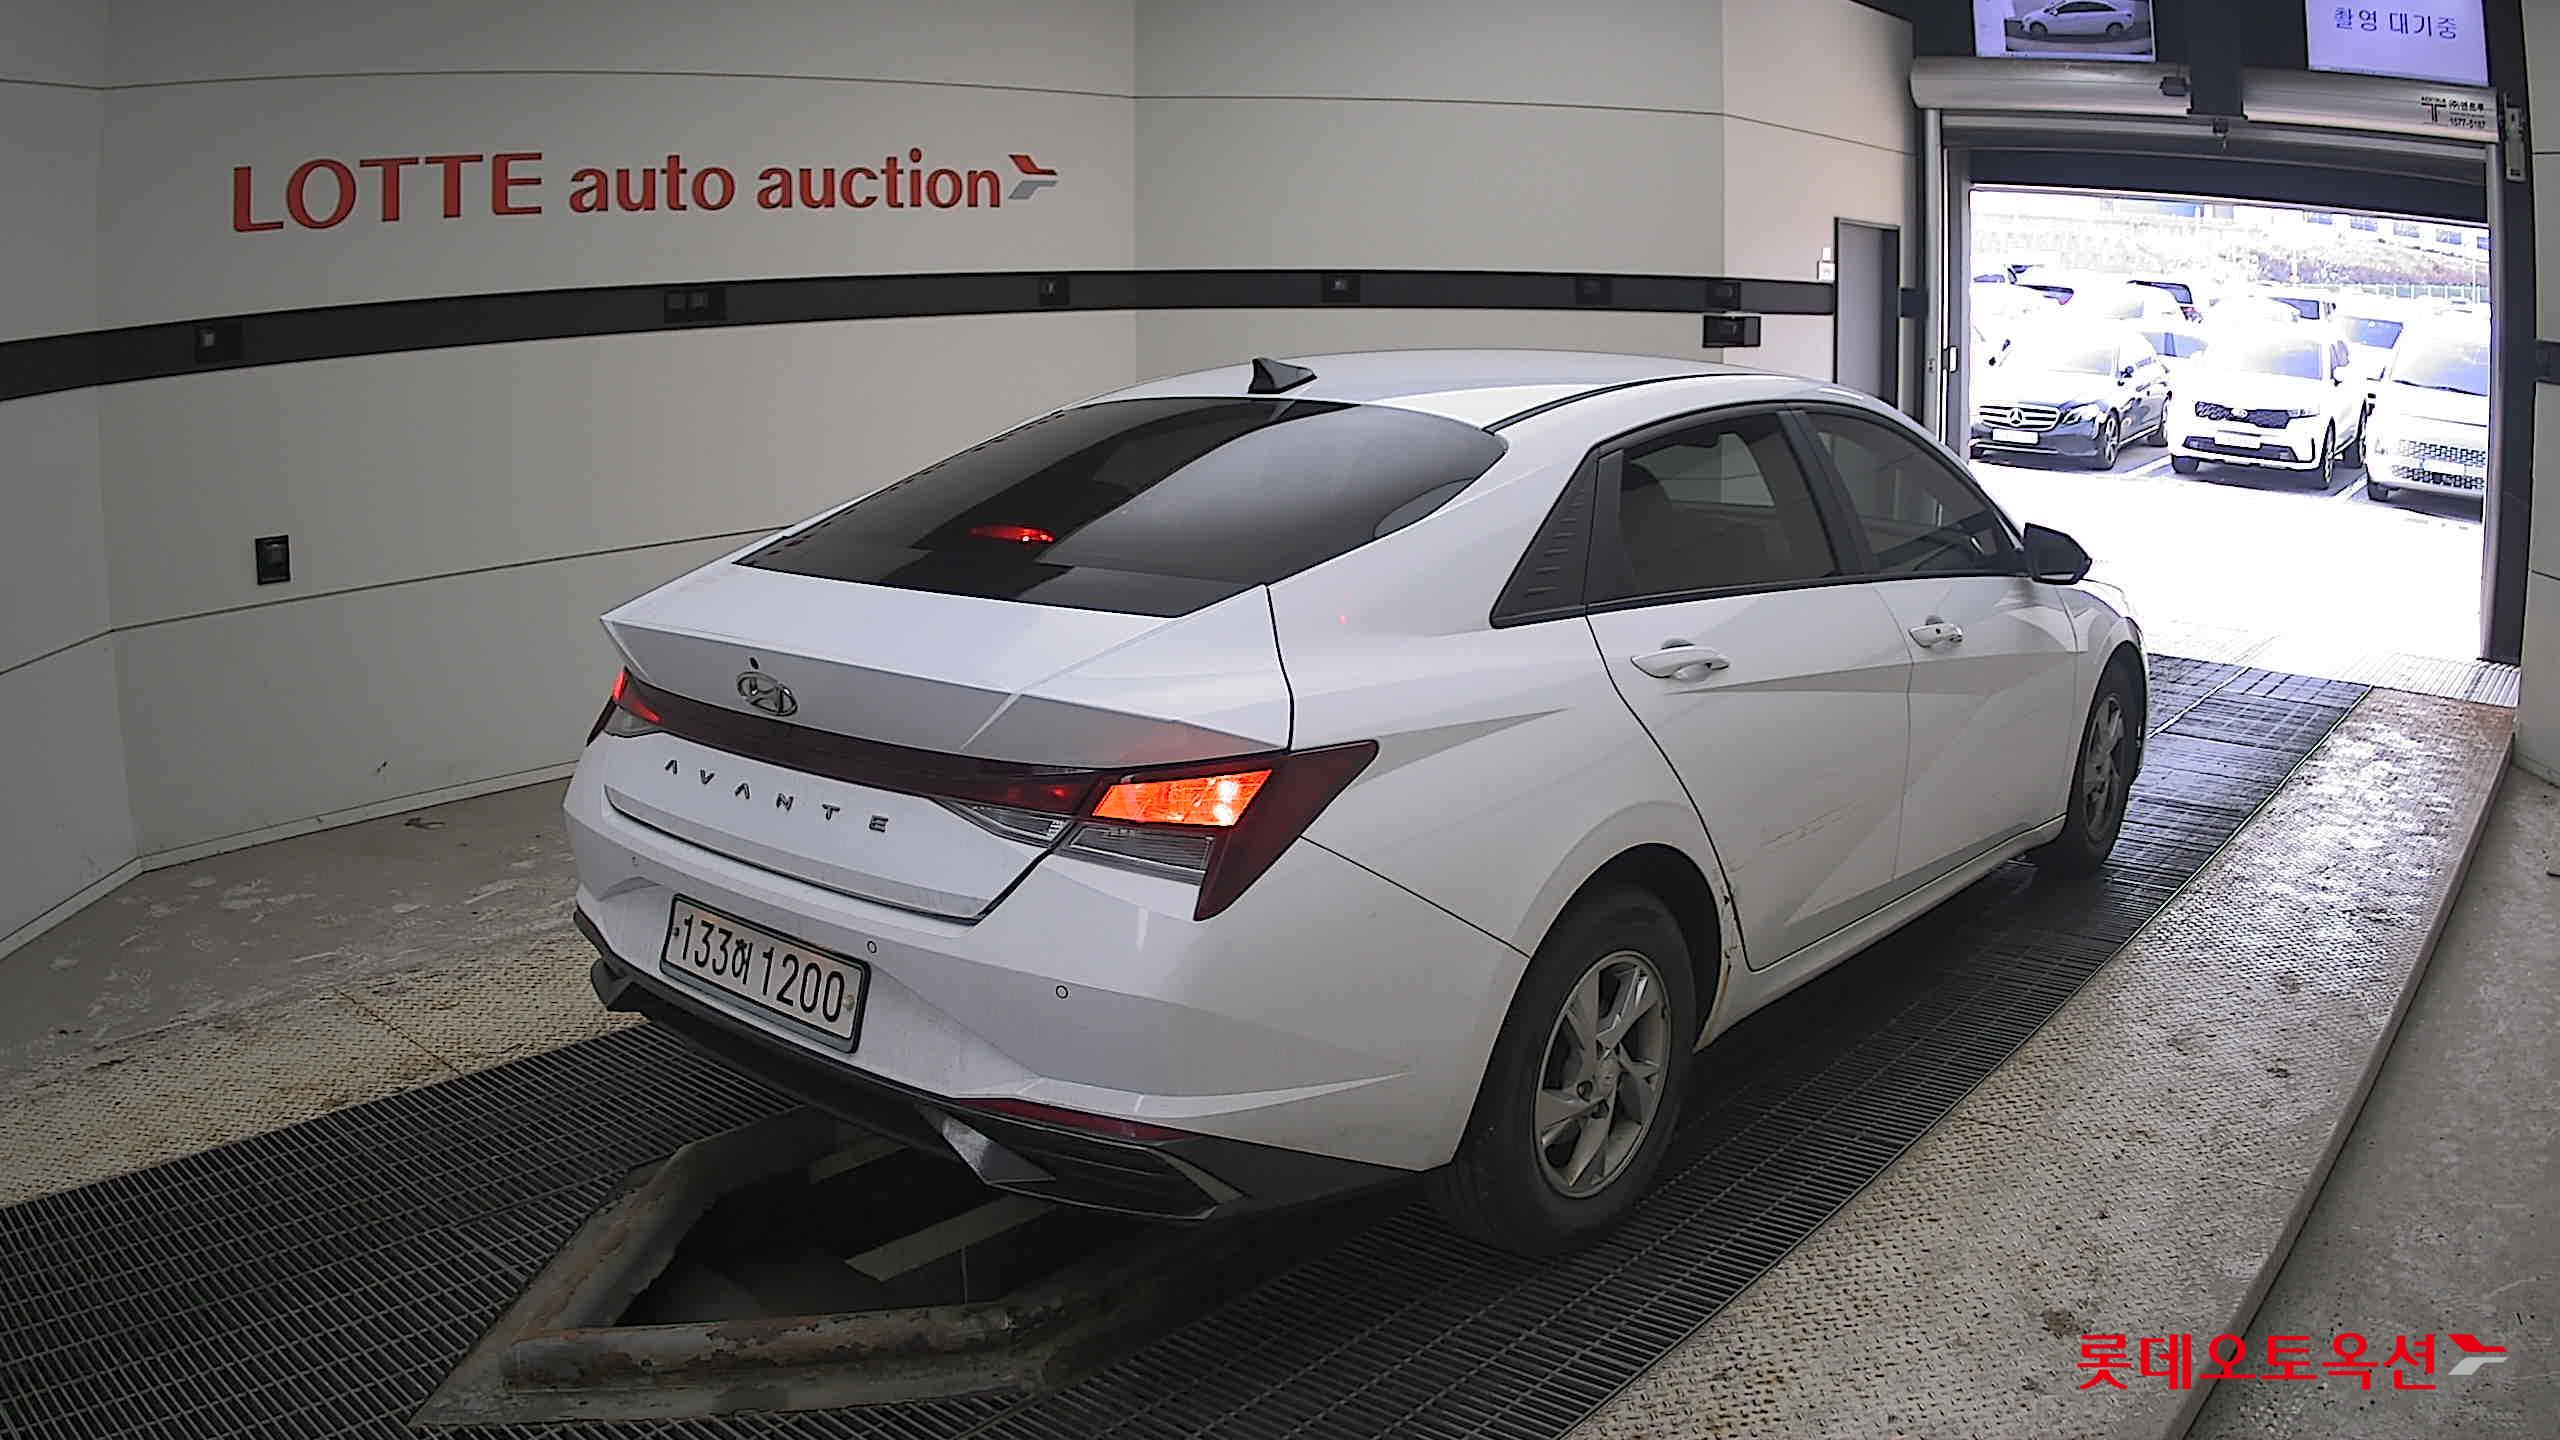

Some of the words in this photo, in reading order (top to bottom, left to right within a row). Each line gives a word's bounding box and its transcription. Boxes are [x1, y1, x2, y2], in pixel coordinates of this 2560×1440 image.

[2335, 7, 2378, 32] 촬영
[2388, 11, 2457, 40] 대기중
[233, 151, 542, 233] LOTTE
[568, 153, 737, 213] auto
[757, 147, 1002, 210] auction
[664, 759, 890, 834] AVANTE
